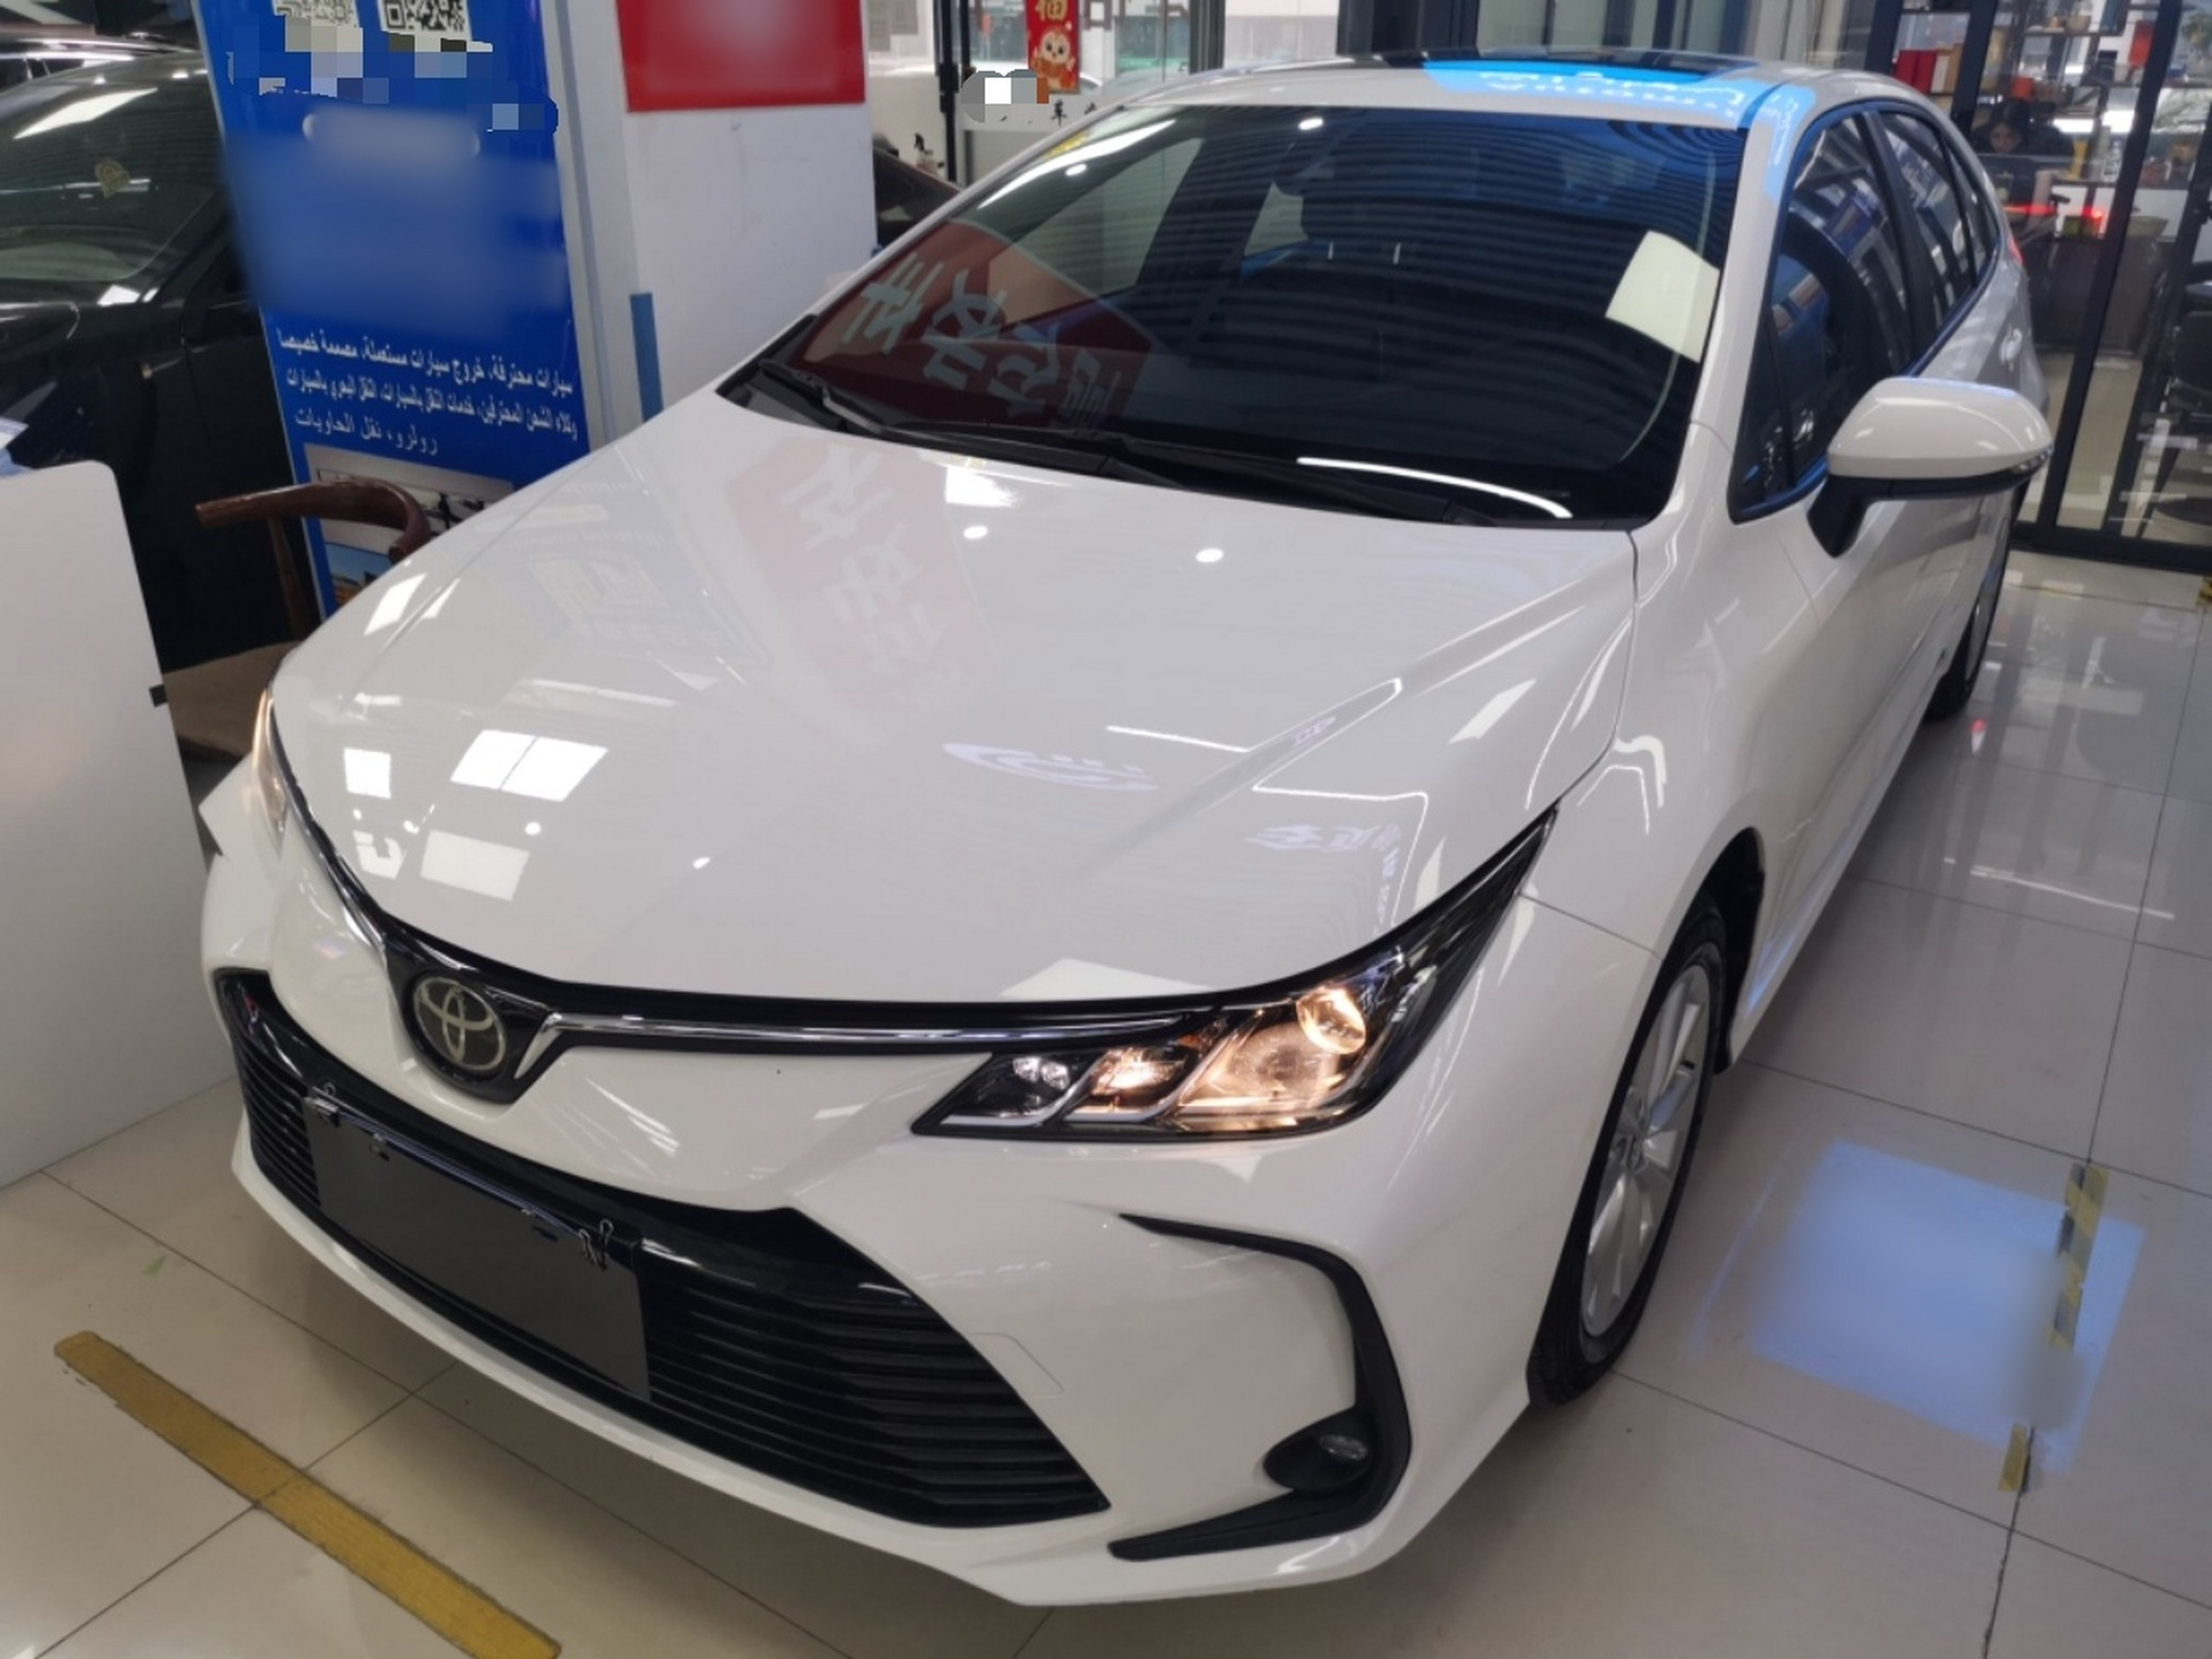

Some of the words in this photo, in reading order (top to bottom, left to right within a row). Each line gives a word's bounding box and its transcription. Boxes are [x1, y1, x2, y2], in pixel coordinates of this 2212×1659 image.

[410, 349, 450, 378] سيارات
[535, 369, 573, 399] سيارات
[294, 407, 355, 435] الحاويات
[360, 415, 382, 440] نقل
